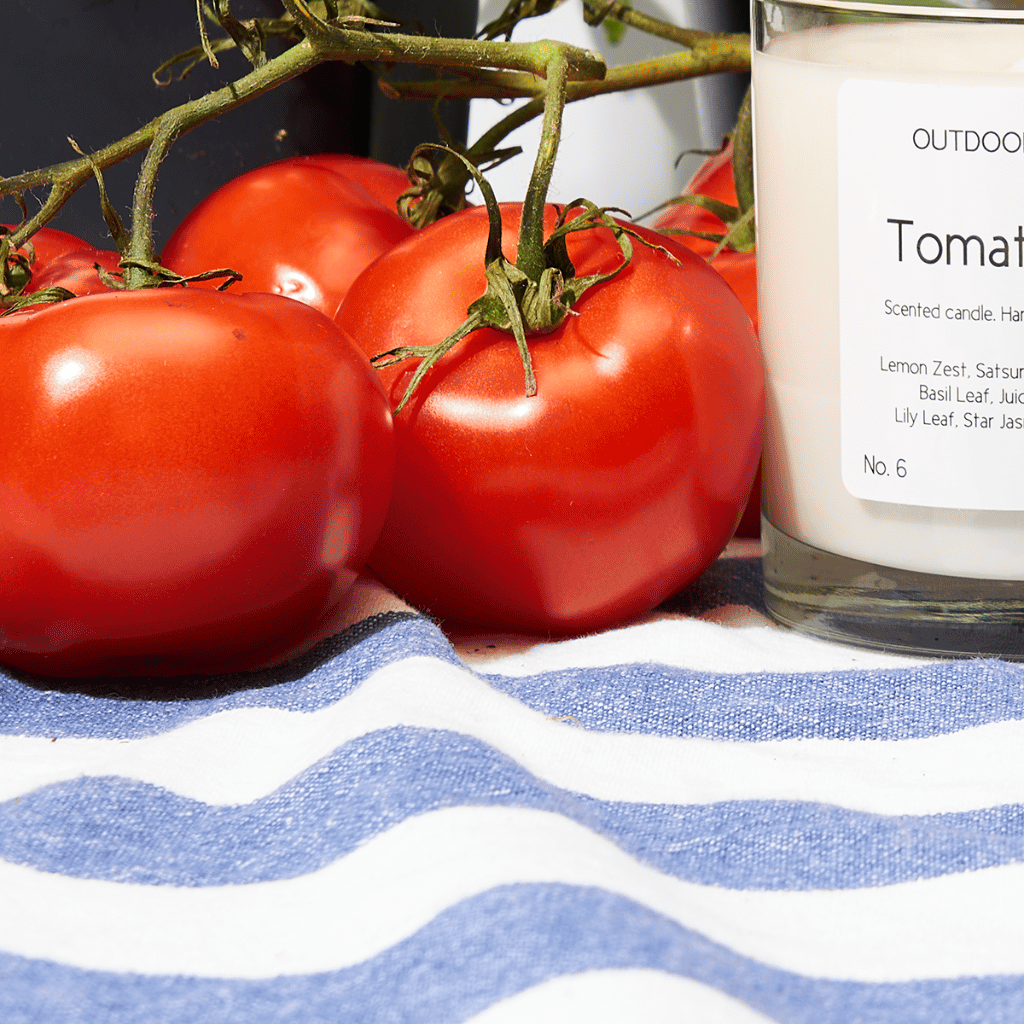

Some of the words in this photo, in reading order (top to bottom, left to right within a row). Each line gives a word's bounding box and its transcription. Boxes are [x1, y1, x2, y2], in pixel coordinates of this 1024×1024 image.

[884, 299, 941, 319] Scented
[944, 304, 996, 322] candle.
[880, 355, 928, 375] Lemon
[932, 359, 972, 379] Zest,
[919, 384, 952, 402] Basil
[956, 386, 994, 405] Leaf,
[894, 408, 919, 428] Lily
[922, 409, 959, 428] Leaf,
[963, 411, 995, 429] Star
[863, 453, 891, 477] No.
[896, 458, 908, 479] 6
